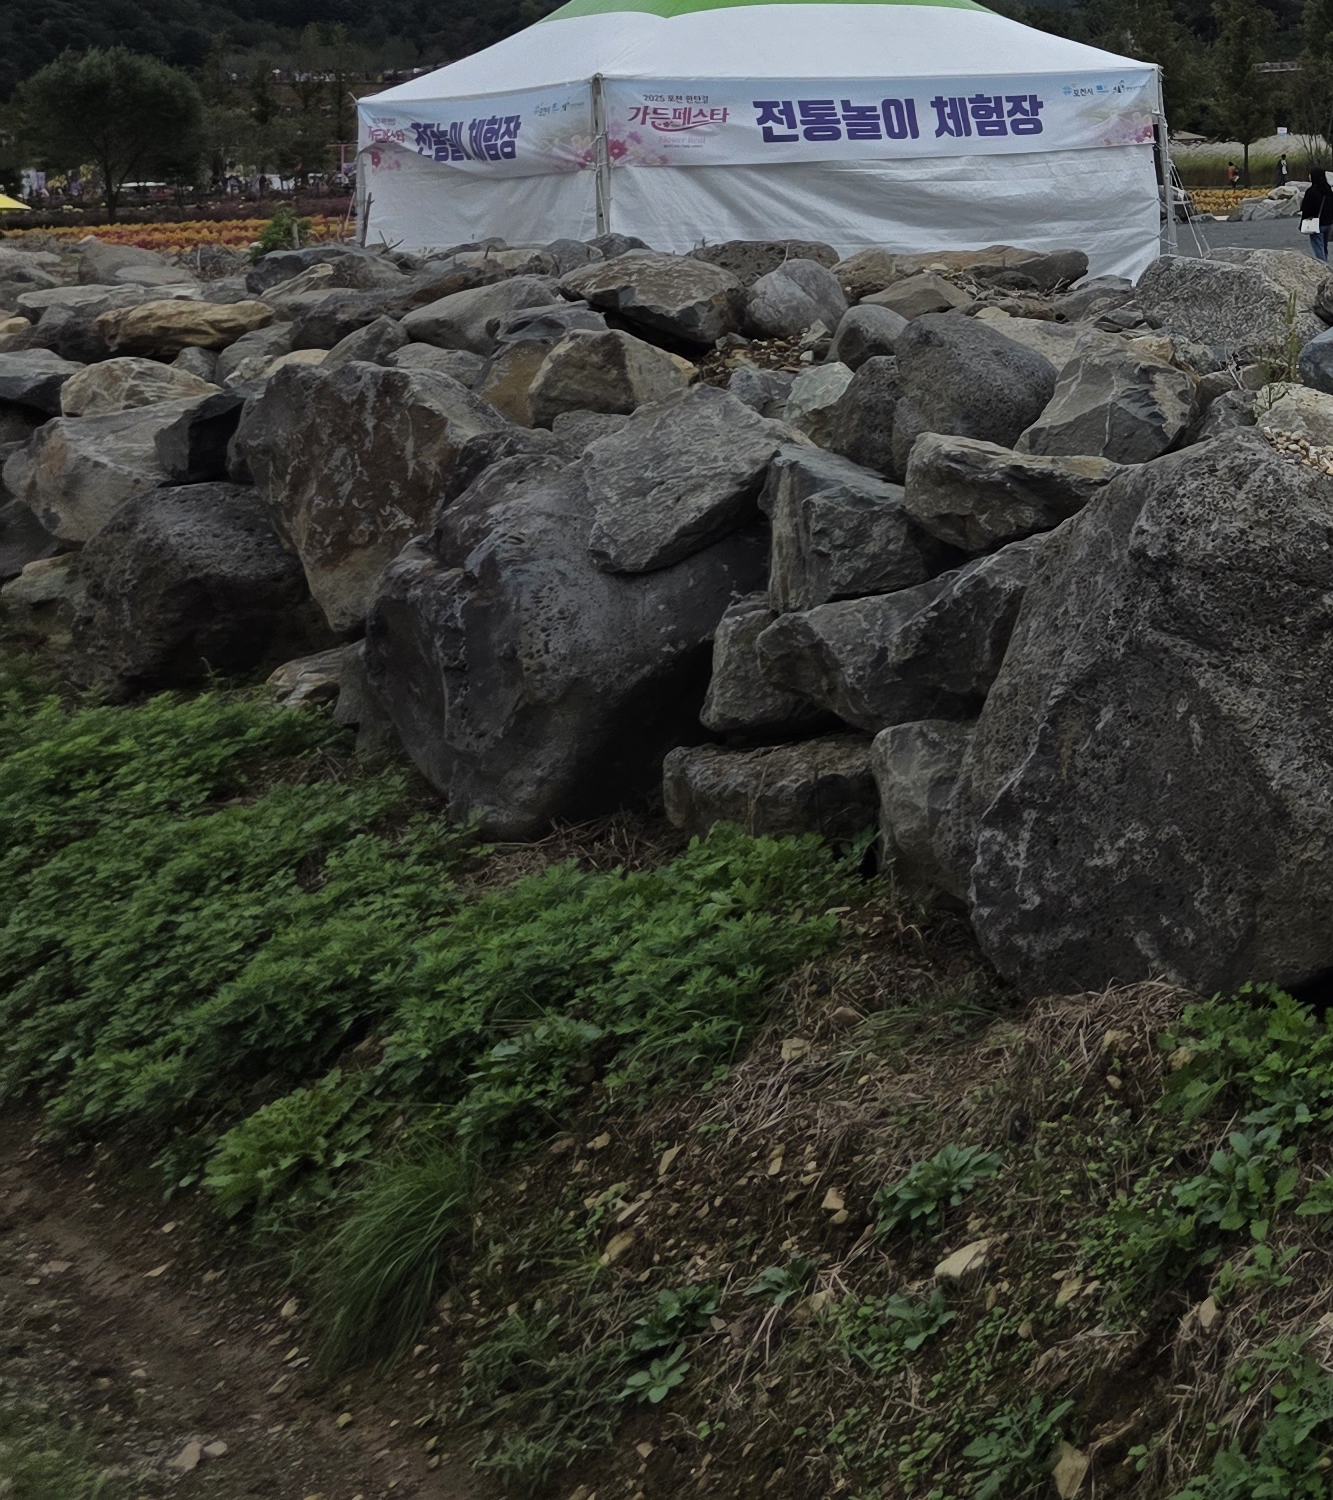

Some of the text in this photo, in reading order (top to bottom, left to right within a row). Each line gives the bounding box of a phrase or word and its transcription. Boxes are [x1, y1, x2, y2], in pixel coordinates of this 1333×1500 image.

[643, 94, 665, 102] 2025
[1073, 88, 1094, 97] 포천시
[627, 105, 730, 132] 가든페스타
[752, 93, 1045, 143] 전통놀이 체험장
[468, 114, 522, 163] 체험장
